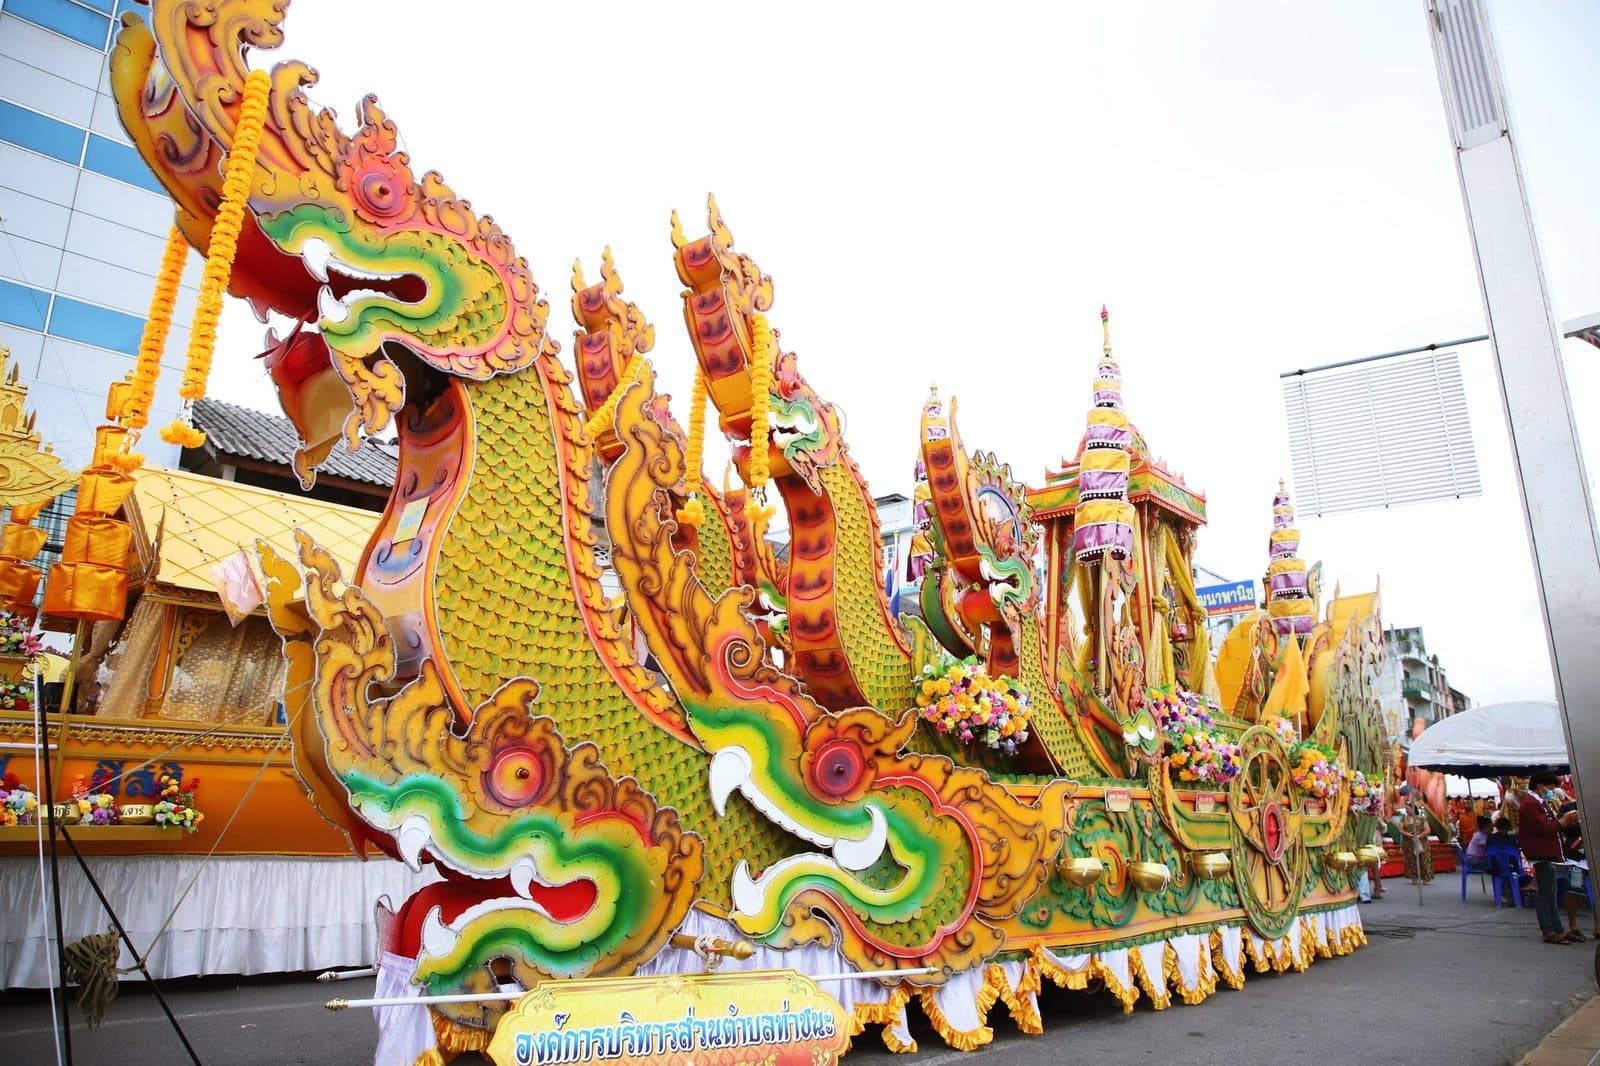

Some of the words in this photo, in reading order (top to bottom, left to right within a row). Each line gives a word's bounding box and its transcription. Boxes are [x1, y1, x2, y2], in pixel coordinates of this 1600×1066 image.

[515, 1000, 835, 1066] องค์การบริหารส่วนตำบลท่าชนะ
